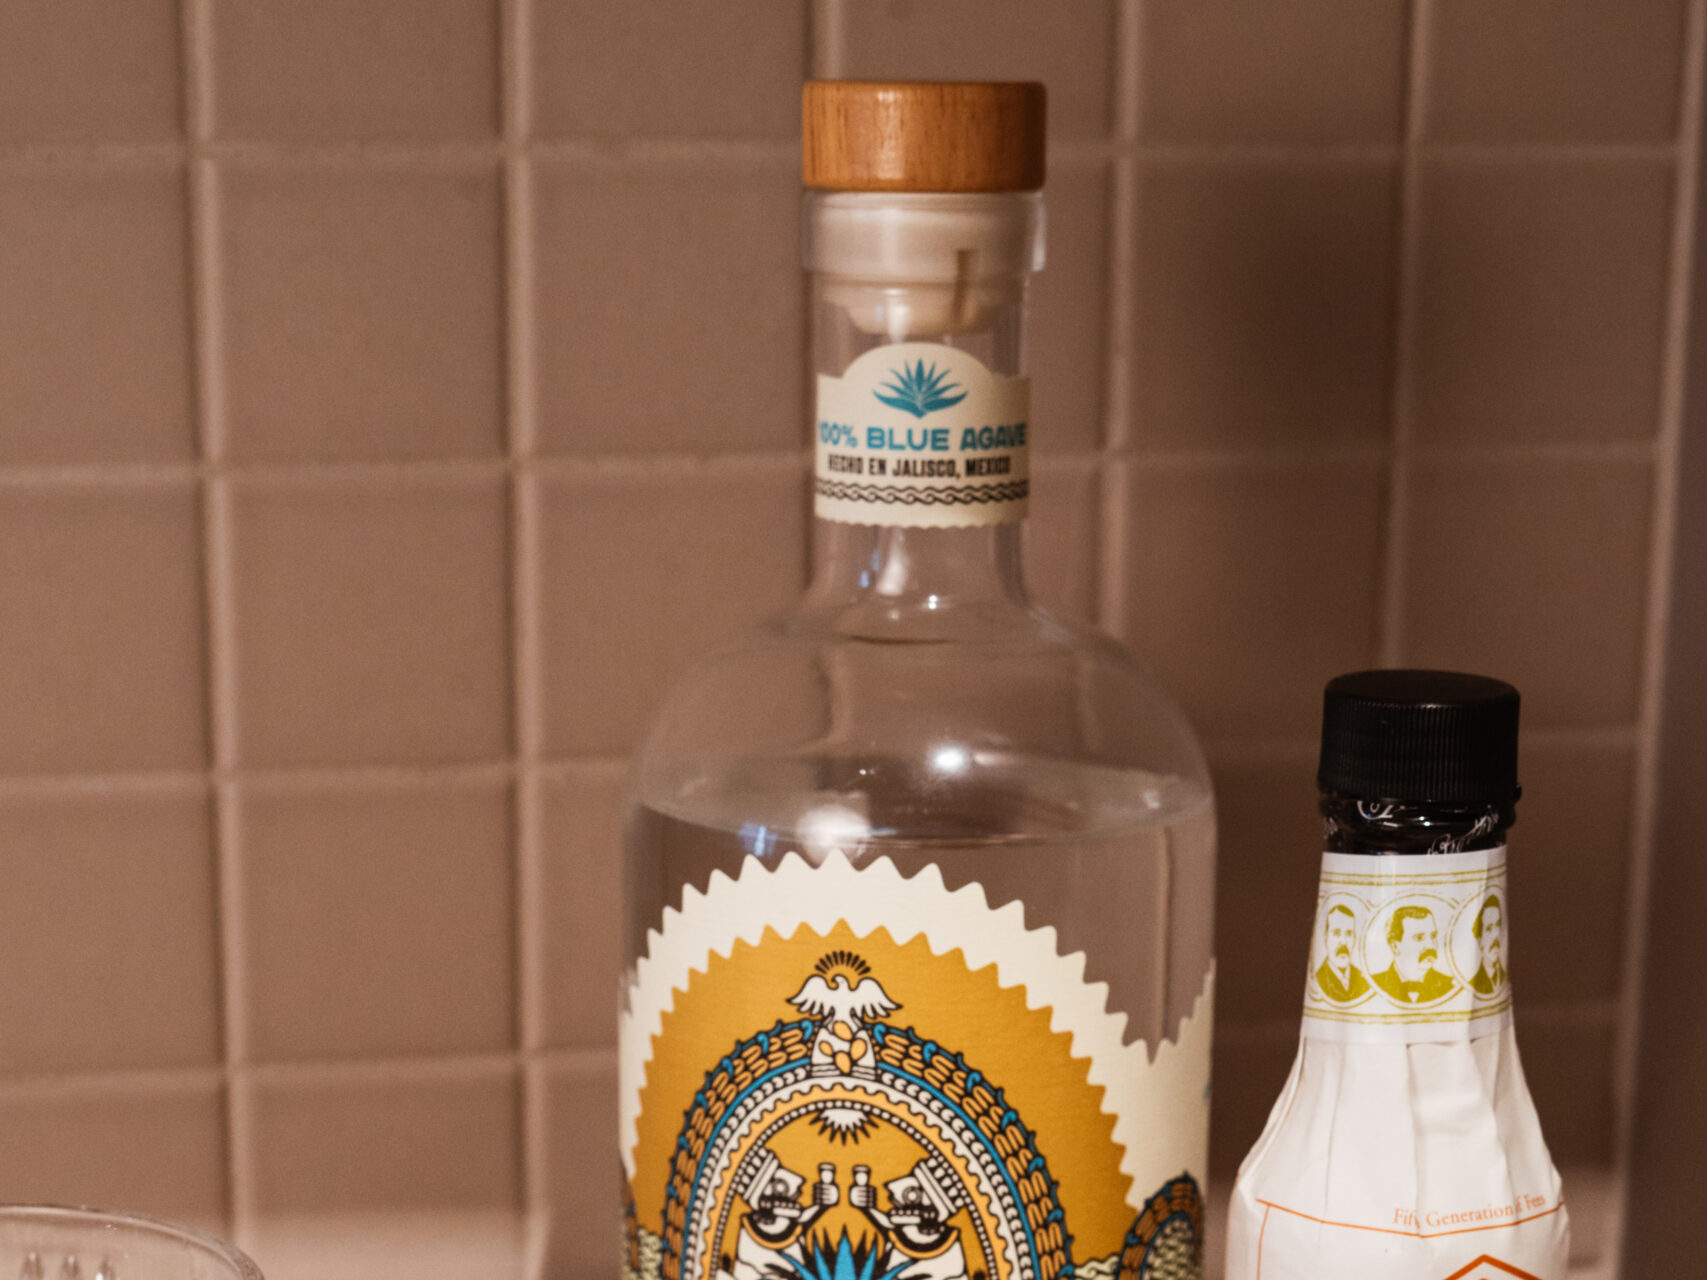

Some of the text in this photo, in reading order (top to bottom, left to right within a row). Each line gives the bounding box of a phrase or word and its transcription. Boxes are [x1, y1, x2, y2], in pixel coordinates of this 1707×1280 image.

[866, 426, 950, 451] BLUE
[960, 422, 1027, 451] AGAVE
[869, 457, 887, 476] EN
[892, 458, 960, 479] JALISCO,
[1425, 1202, 1515, 1228] Generation
